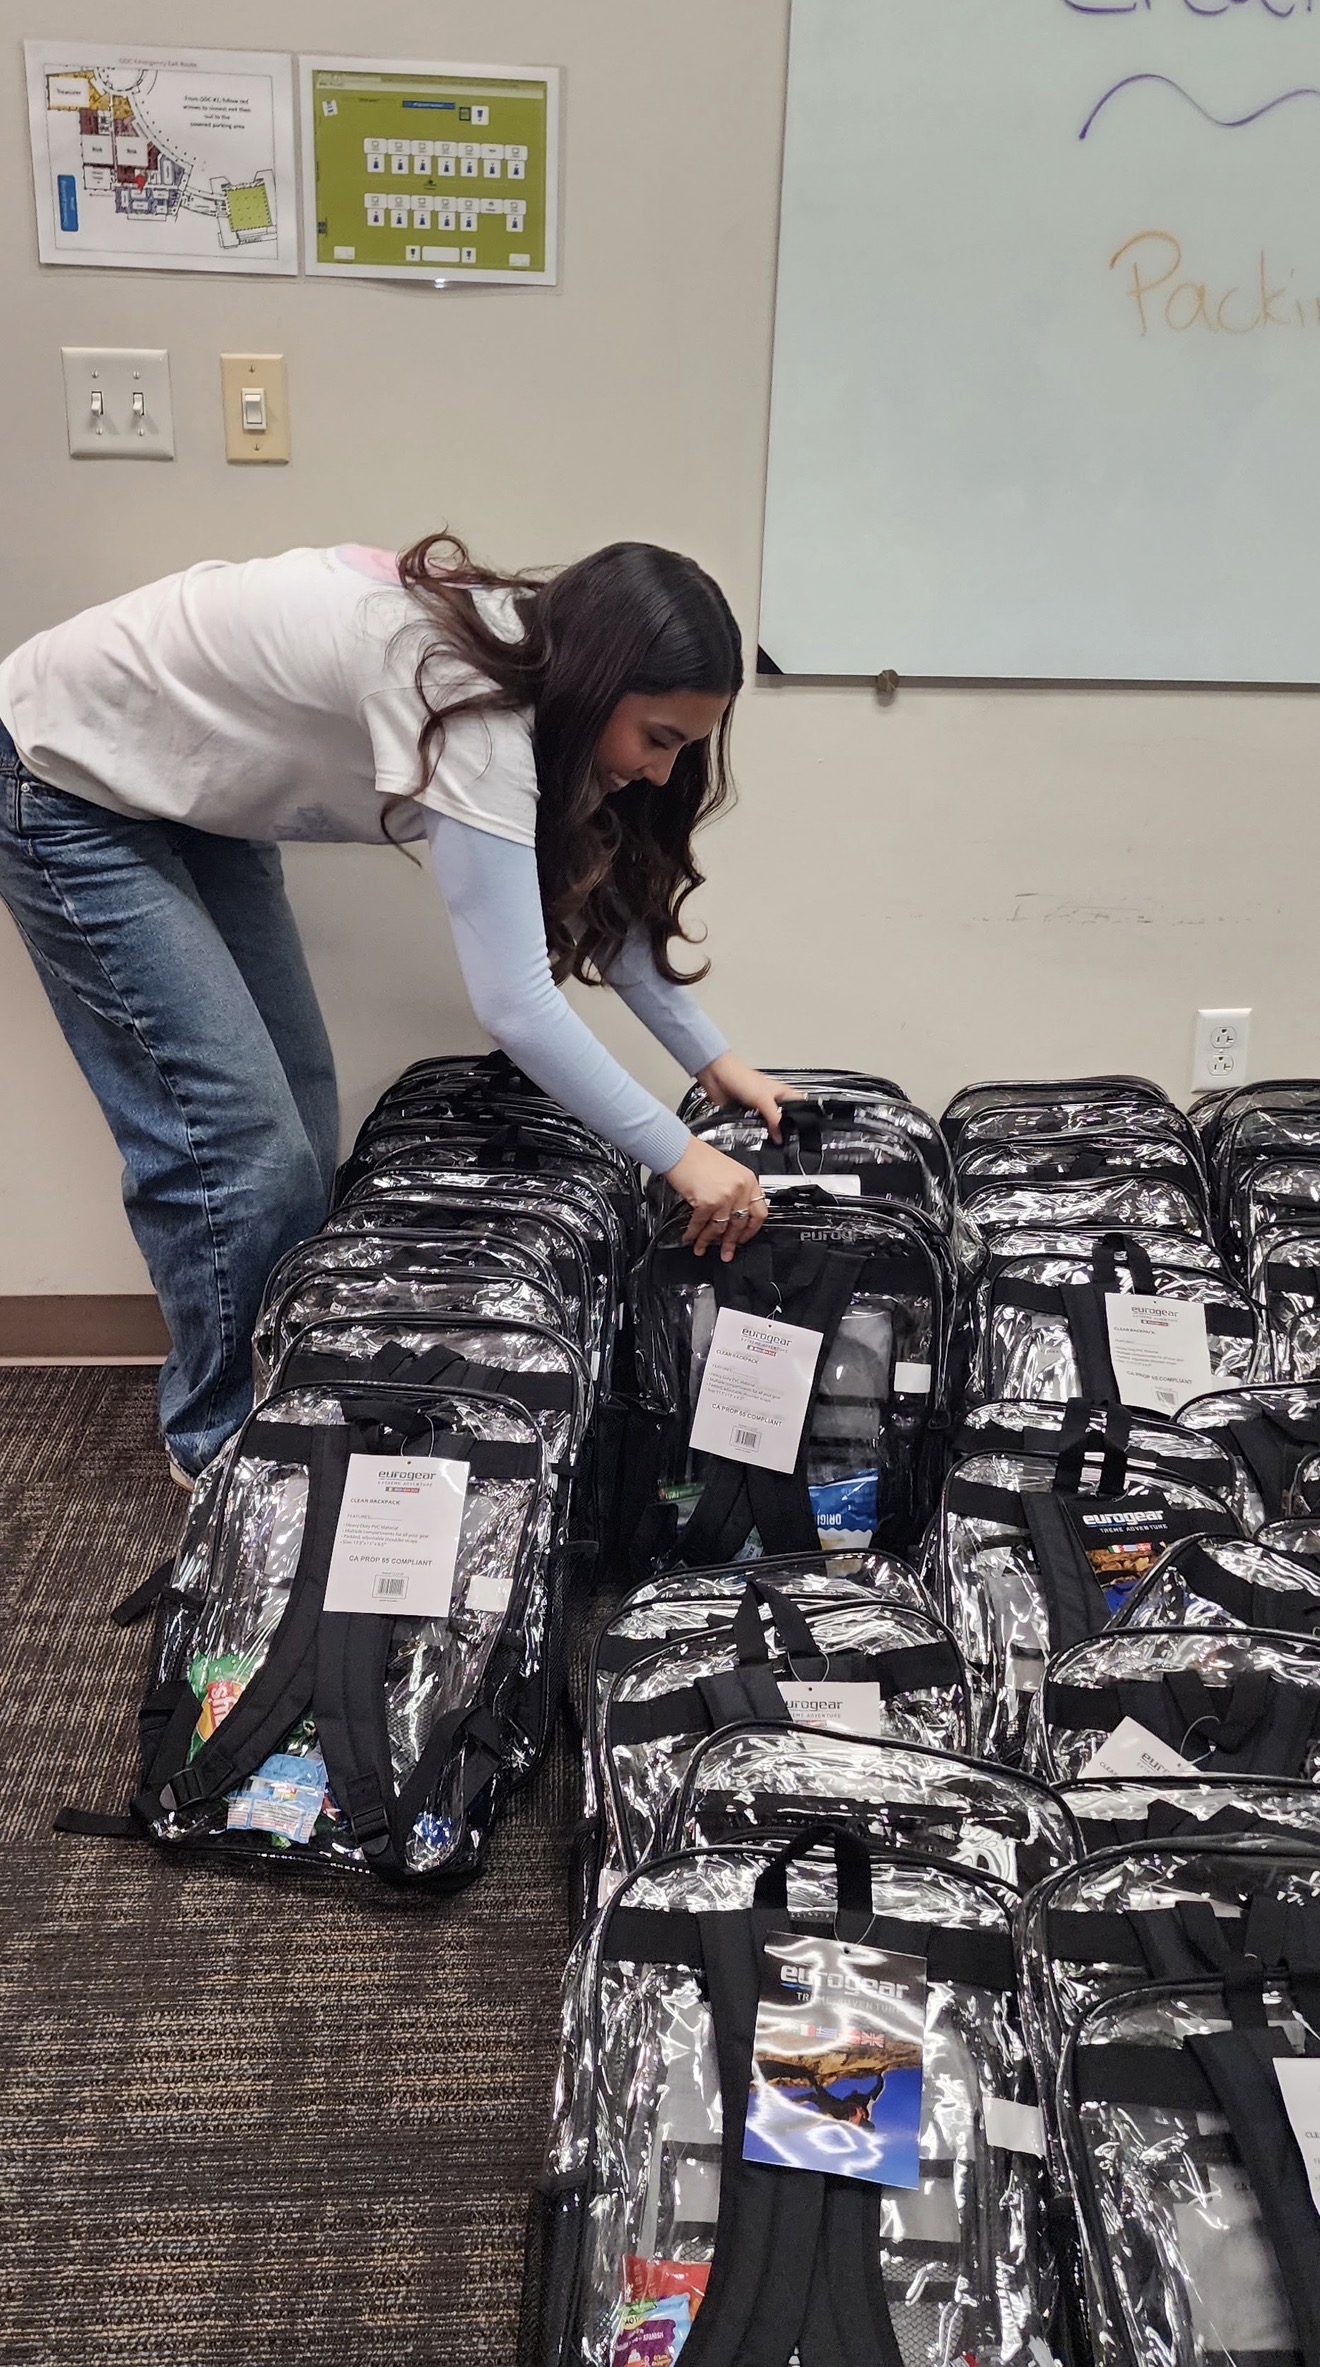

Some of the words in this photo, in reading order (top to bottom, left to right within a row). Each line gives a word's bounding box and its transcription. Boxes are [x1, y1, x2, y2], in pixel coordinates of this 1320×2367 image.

[1109, 229, 1320, 337] Packi
[1131, 1306, 1179, 1317] eurogear
[741, 1328, 793, 1347] eurogear
[715, 1349, 732, 1357] CLEAR
[732, 1353, 759, 1364] BACKPACK
[1159, 1376, 1193, 1385] COMPLIANT
[711, 1403, 721, 1411] CA
[721, 1405, 739, 1415] PROP
[739, 1410, 746, 1418] 65
[746, 1413, 782, 1427] COMPLIANT
[378, 1470, 437, 1481] eurogear
[1082, 1510, 1164, 1526] eurogear
[1099, 1526, 1125, 1534] TREME
[1126, 1523, 1168, 1532] ADVENTURE
[360, 1555, 381, 1563] PROP
[390, 1558, 433, 1567] COMPLIANT
[785, 1700, 843, 1711] urogear
[780, 1963, 911, 1999] eurogear
